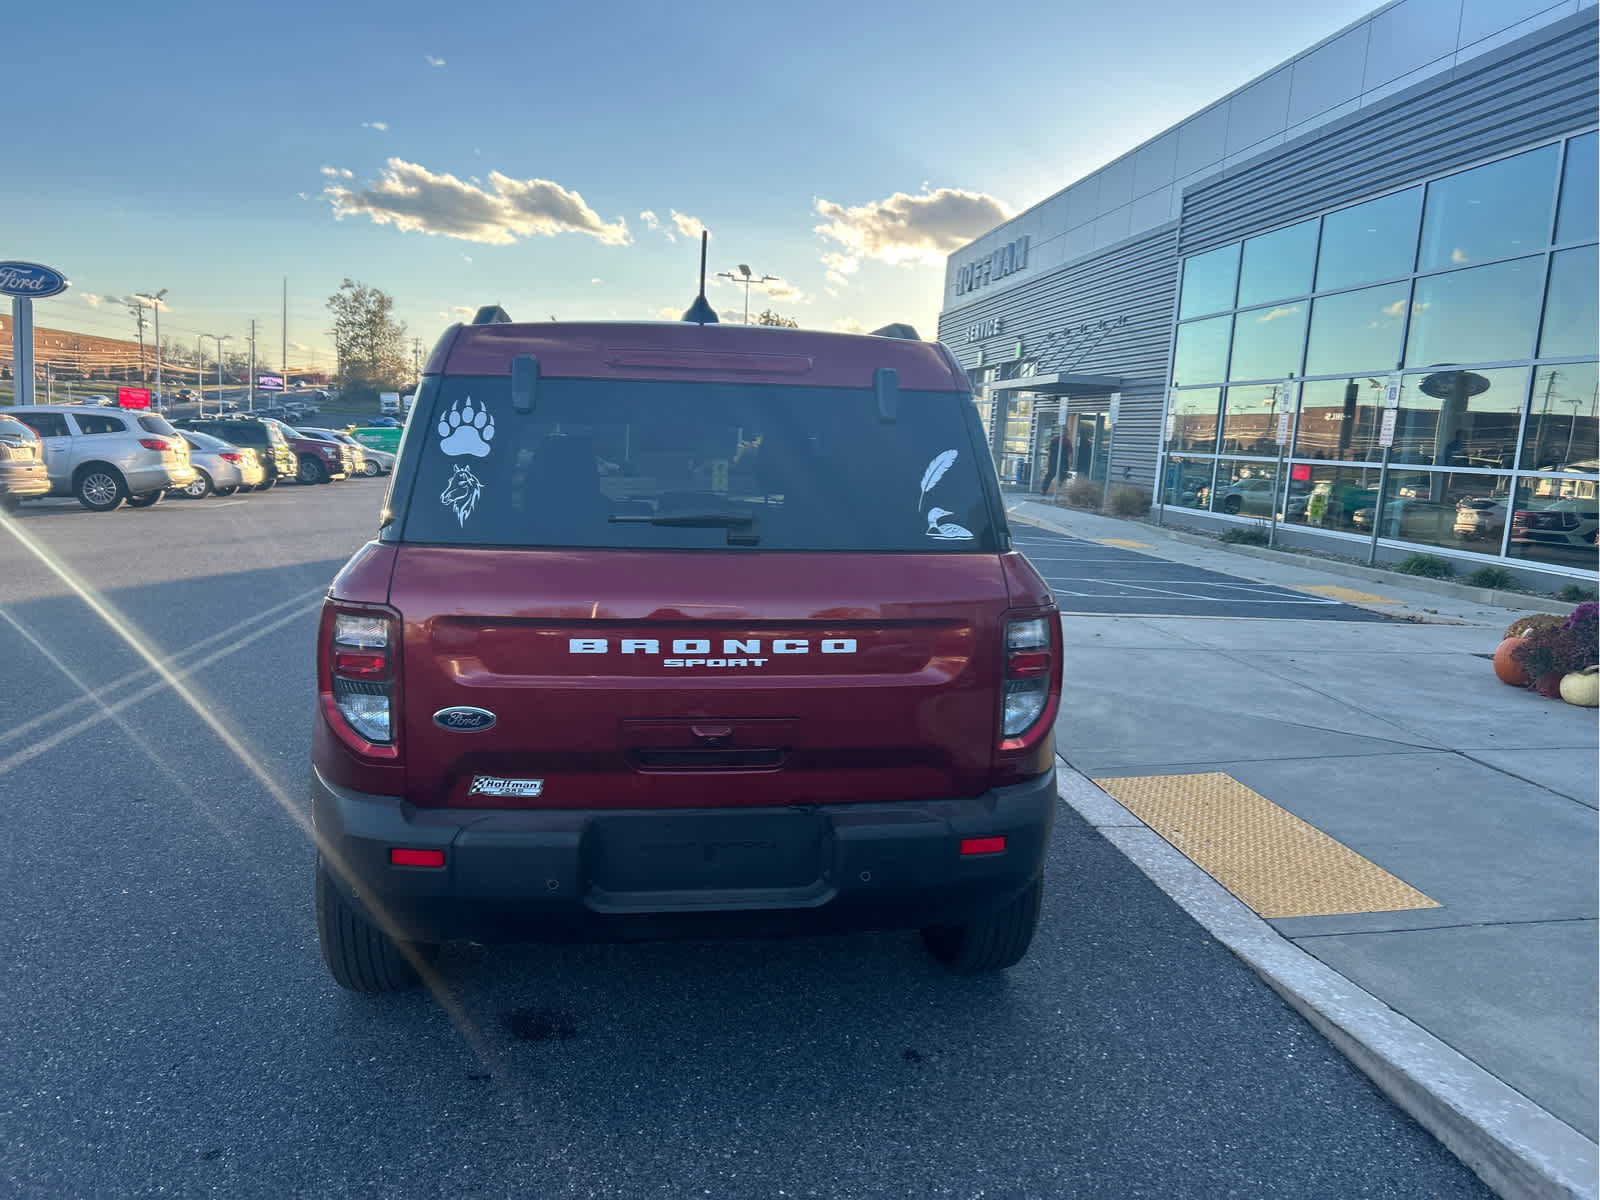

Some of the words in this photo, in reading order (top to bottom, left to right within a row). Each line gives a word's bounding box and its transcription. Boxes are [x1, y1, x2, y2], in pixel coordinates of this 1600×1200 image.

[955, 235, 1031, 297] HOFFMAN
[0, 266, 46, 290] Ford
[965, 318, 1002, 343] SERVICE
[569, 639, 857, 654] BRONCO
[663, 658, 769, 668] SPORT
[447, 711, 482, 727] Ford
[486, 779, 538, 789] Hoffman
